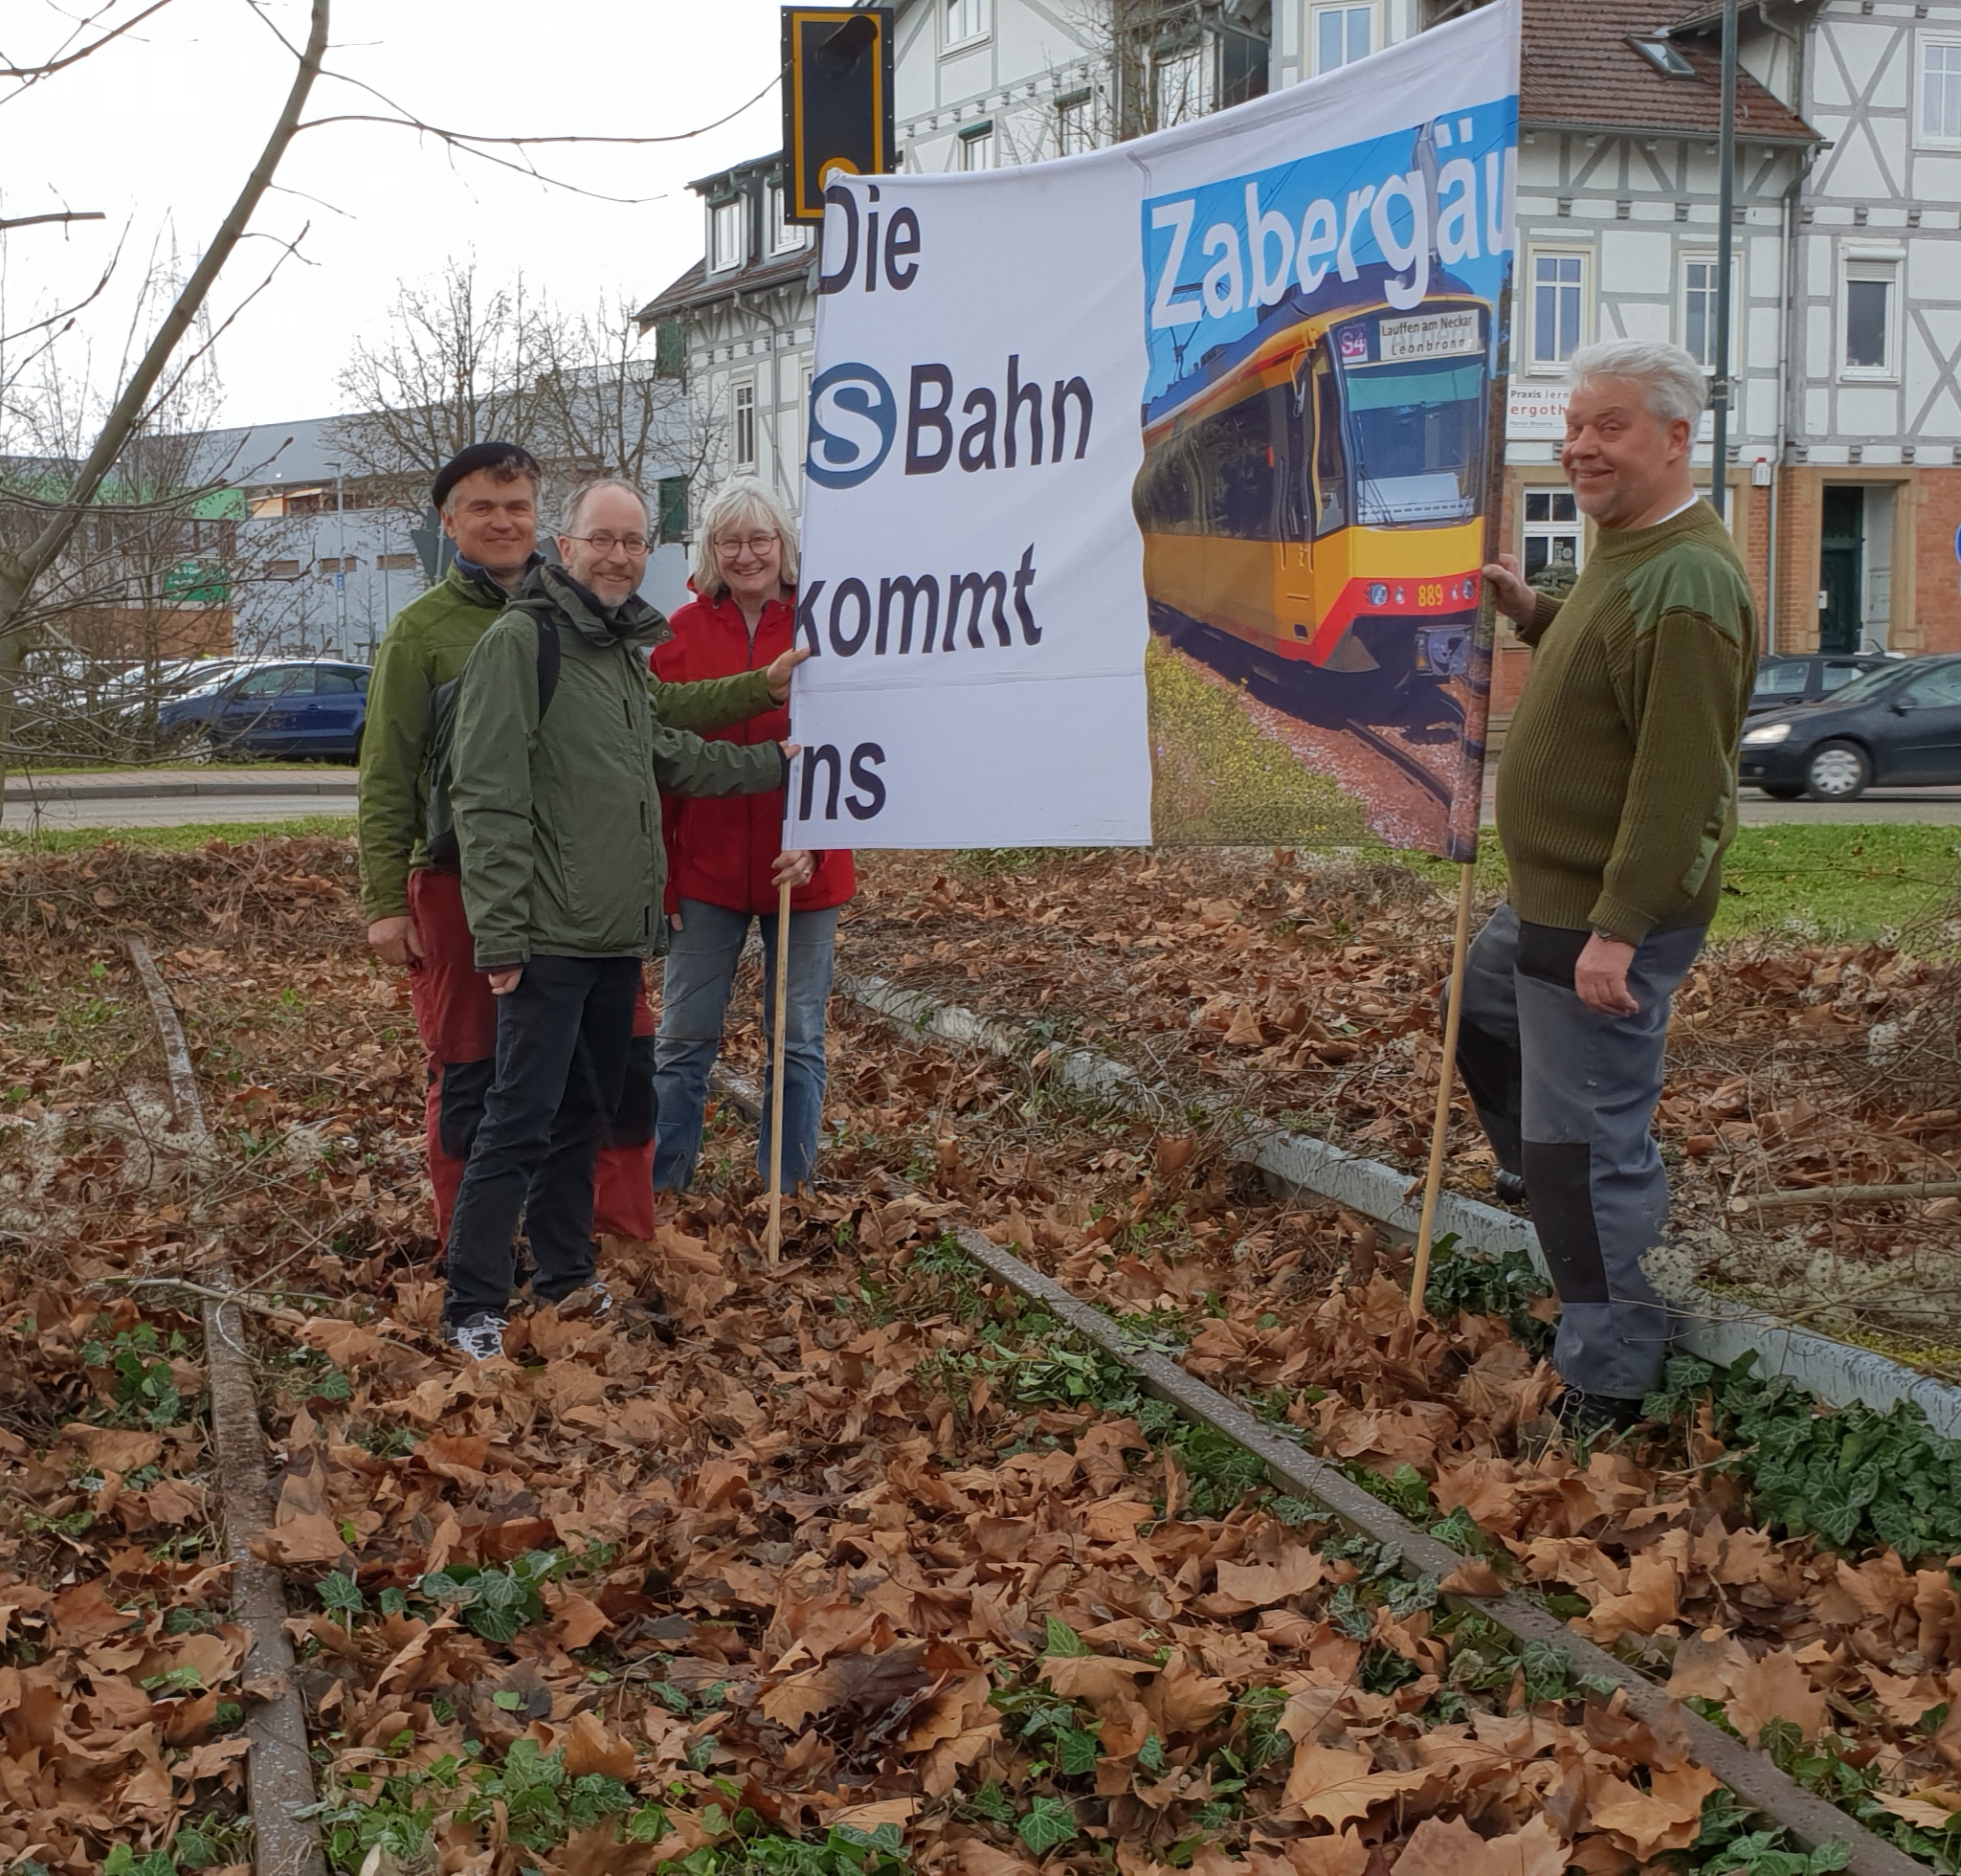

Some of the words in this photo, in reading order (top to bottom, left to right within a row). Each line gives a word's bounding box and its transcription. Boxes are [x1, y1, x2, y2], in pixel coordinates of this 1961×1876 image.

[819, 184, 922, 295] Die
[1151, 117, 1518, 330] Zabergäu
[1341, 330, 1366, 354] S4
[1381, 321, 1420, 337] Lauffen
[1421, 320, 1438, 332] am
[1439, 314, 1473, 330] Neckar
[1391, 338, 1465, 356] Leonbronn
[904, 354, 1093, 477] Bahn
[1510, 390, 1542, 399] Praxis
[793, 541, 1043, 659] kommt
[1417, 584, 1444, 607] 889
[784, 719, 886, 821] ns
